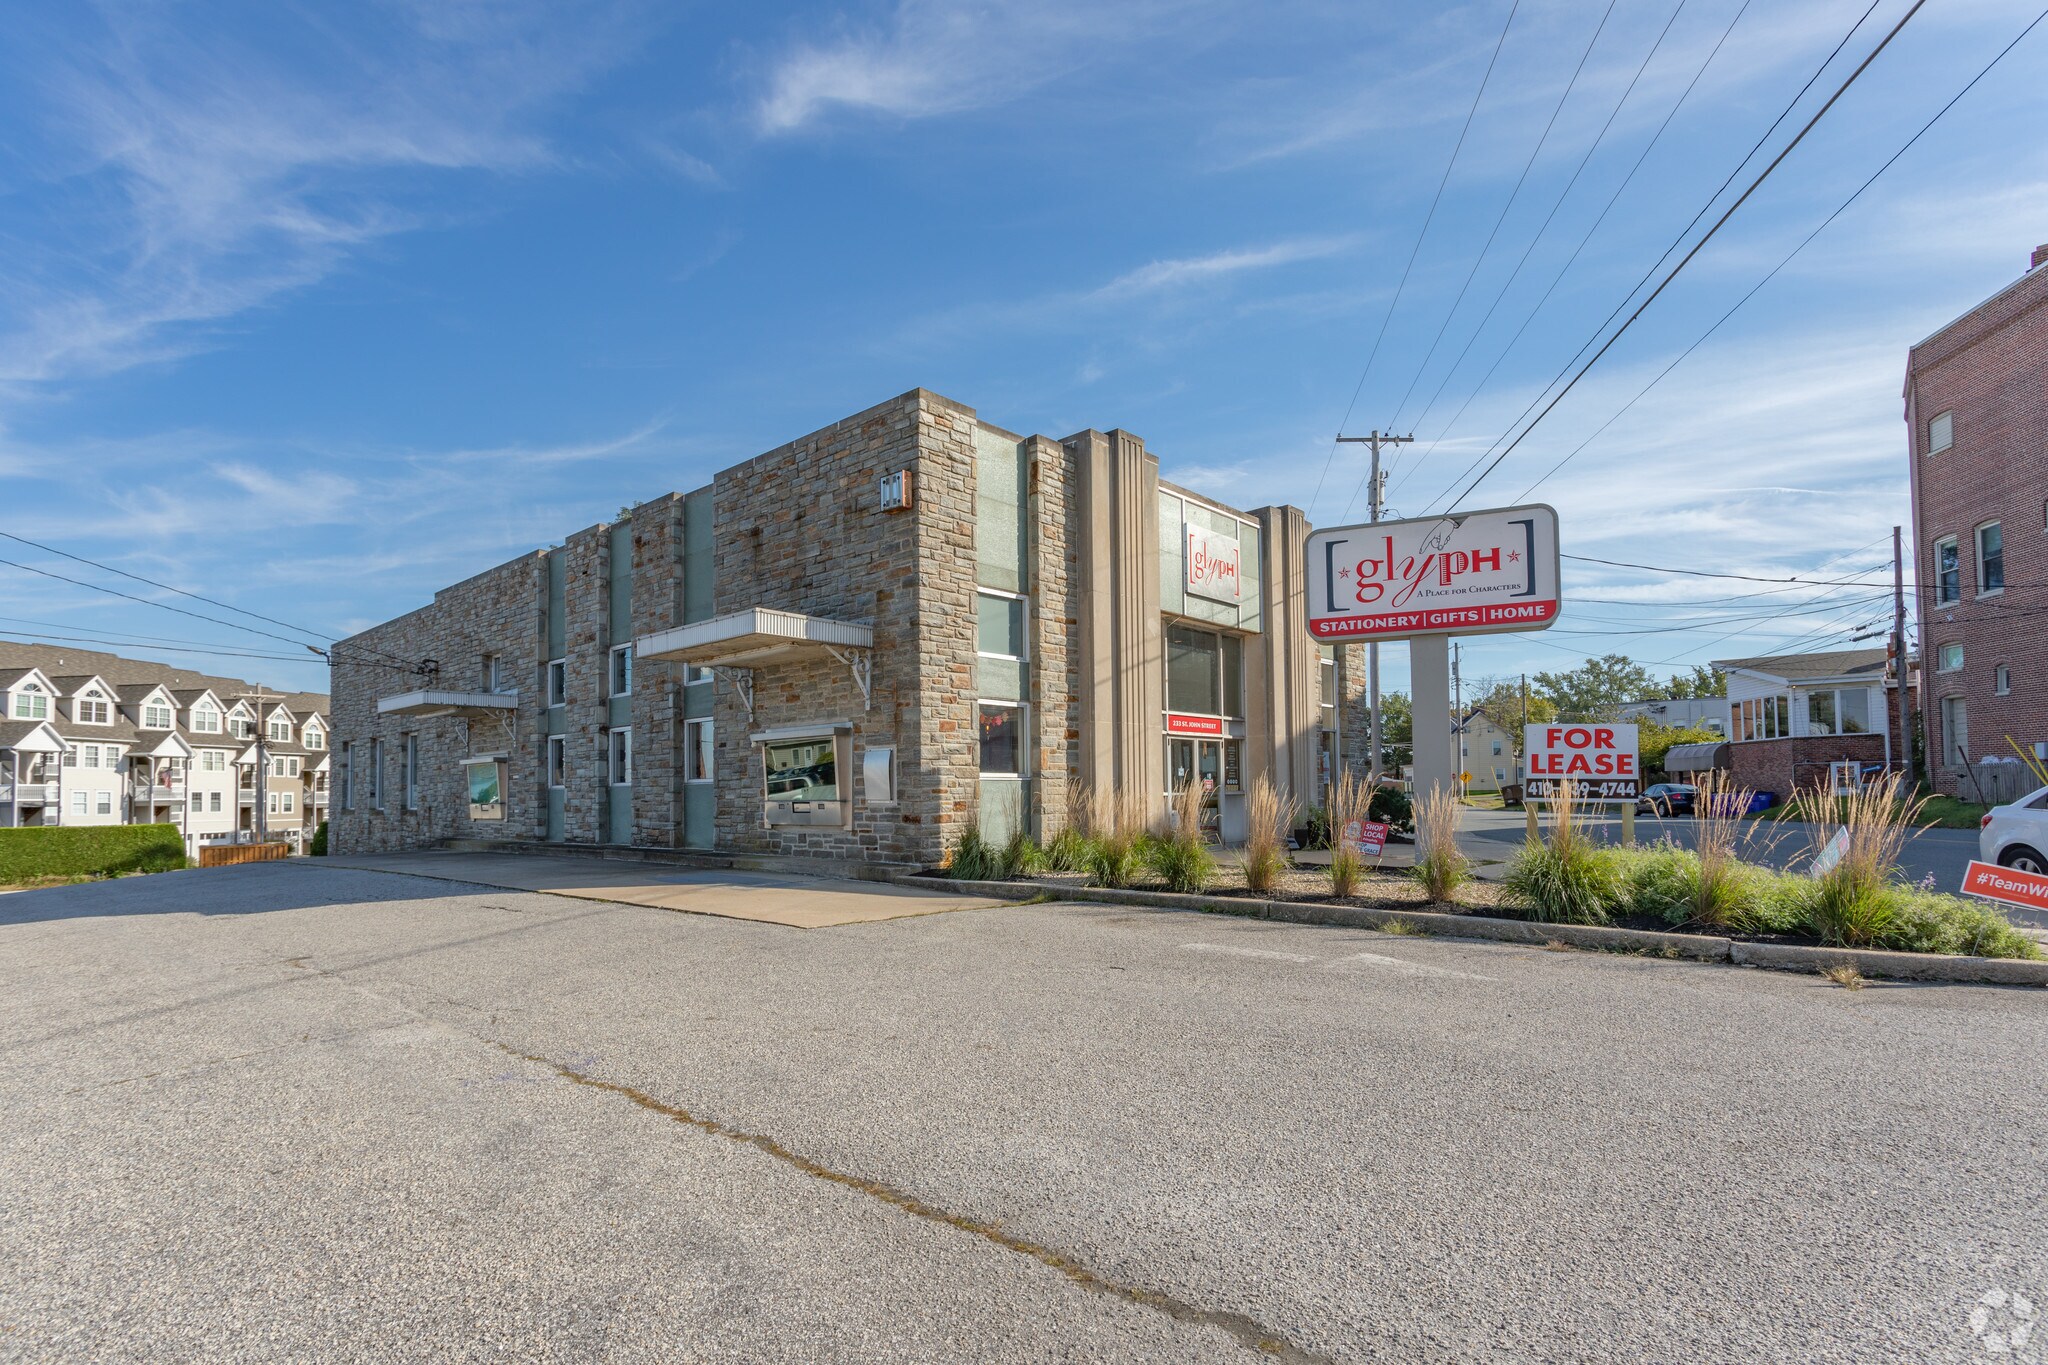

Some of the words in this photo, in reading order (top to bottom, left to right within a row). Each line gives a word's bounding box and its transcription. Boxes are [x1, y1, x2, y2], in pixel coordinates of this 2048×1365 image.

[1417, 590, 1423, 598] A
[1319, 615, 1420, 633] STATIONERY
[1430, 610, 1479, 624] GIFTS
[1490, 605, 1546, 619] HOME
[1547, 728, 1616, 749] FOR
[1531, 754, 1634, 775] LEASE
[1528, 782, 1636, 797] 410-39-4744
[1363, 831, 1384, 839] LOCAL
